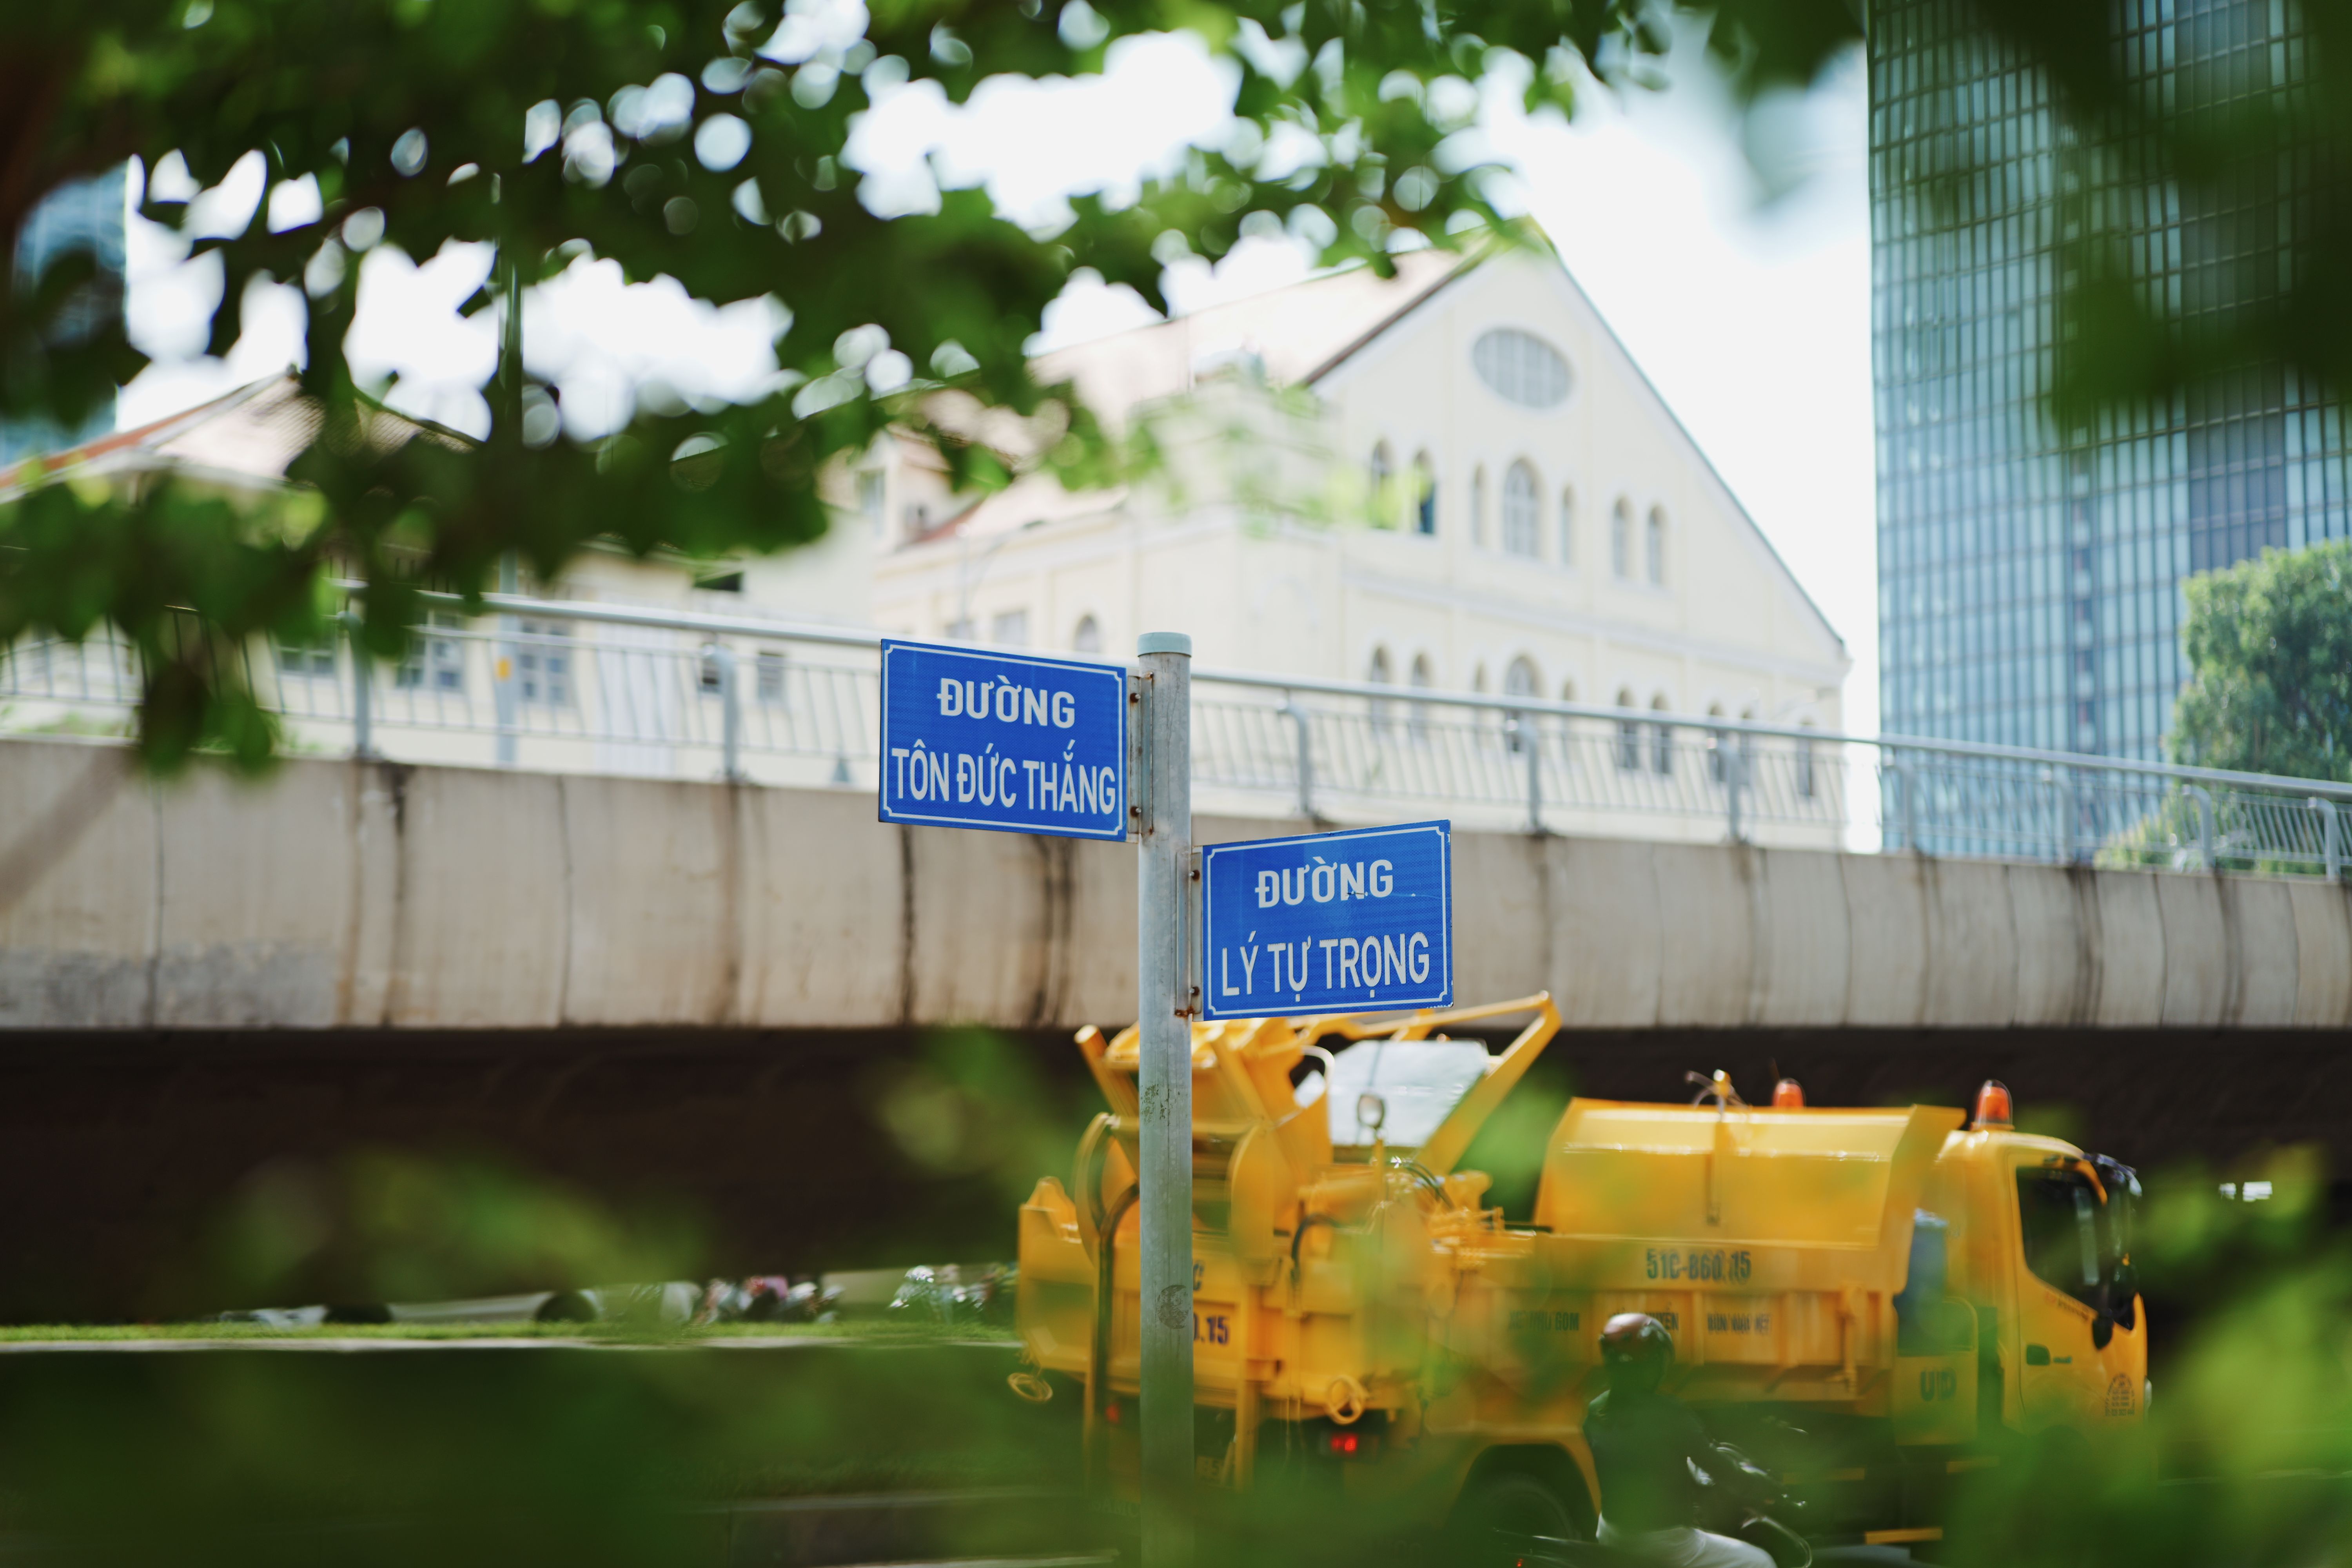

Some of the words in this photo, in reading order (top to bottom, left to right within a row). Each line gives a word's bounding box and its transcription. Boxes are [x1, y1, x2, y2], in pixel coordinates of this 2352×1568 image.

[937, 675, 1075, 728] ĐƯỜNG
[892, 739, 949, 801] TÔN
[957, 743, 1016, 808] ĐỨC
[1023, 739, 1115, 815] THẮNG
[1255, 856, 1393, 908] ĐƯỜNG
[1222, 931, 1259, 996] LÝ
[1267, 936, 1311, 1002] TỰ
[1319, 932, 1430, 998] TRỌNG
[1555, 1311, 1579, 1331] GOM
